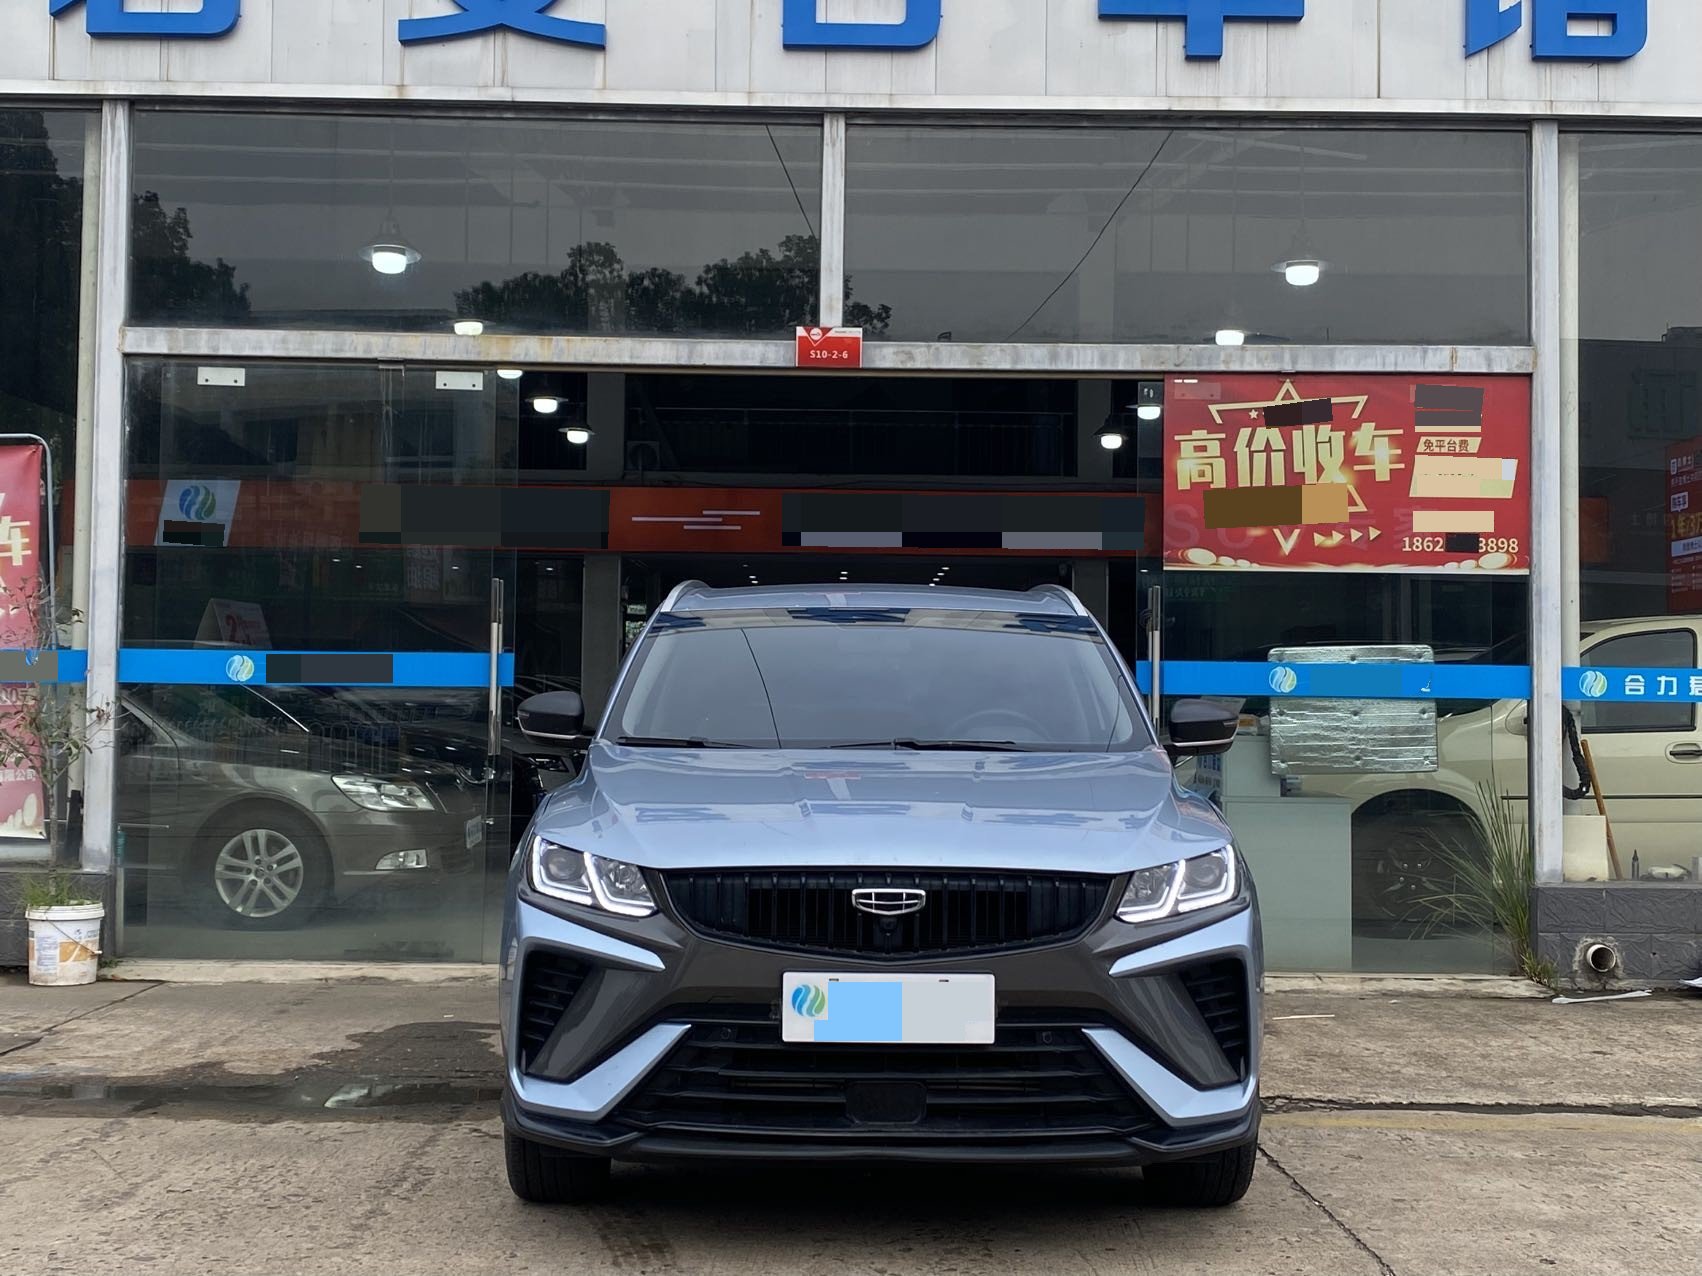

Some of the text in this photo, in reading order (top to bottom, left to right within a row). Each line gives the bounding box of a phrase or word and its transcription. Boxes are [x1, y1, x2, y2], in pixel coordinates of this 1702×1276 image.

[809, 349, 849, 359] S10-2-6
[1174, 421, 1406, 490] 高价收车
[1402, 536, 1519, 553] 18623898
